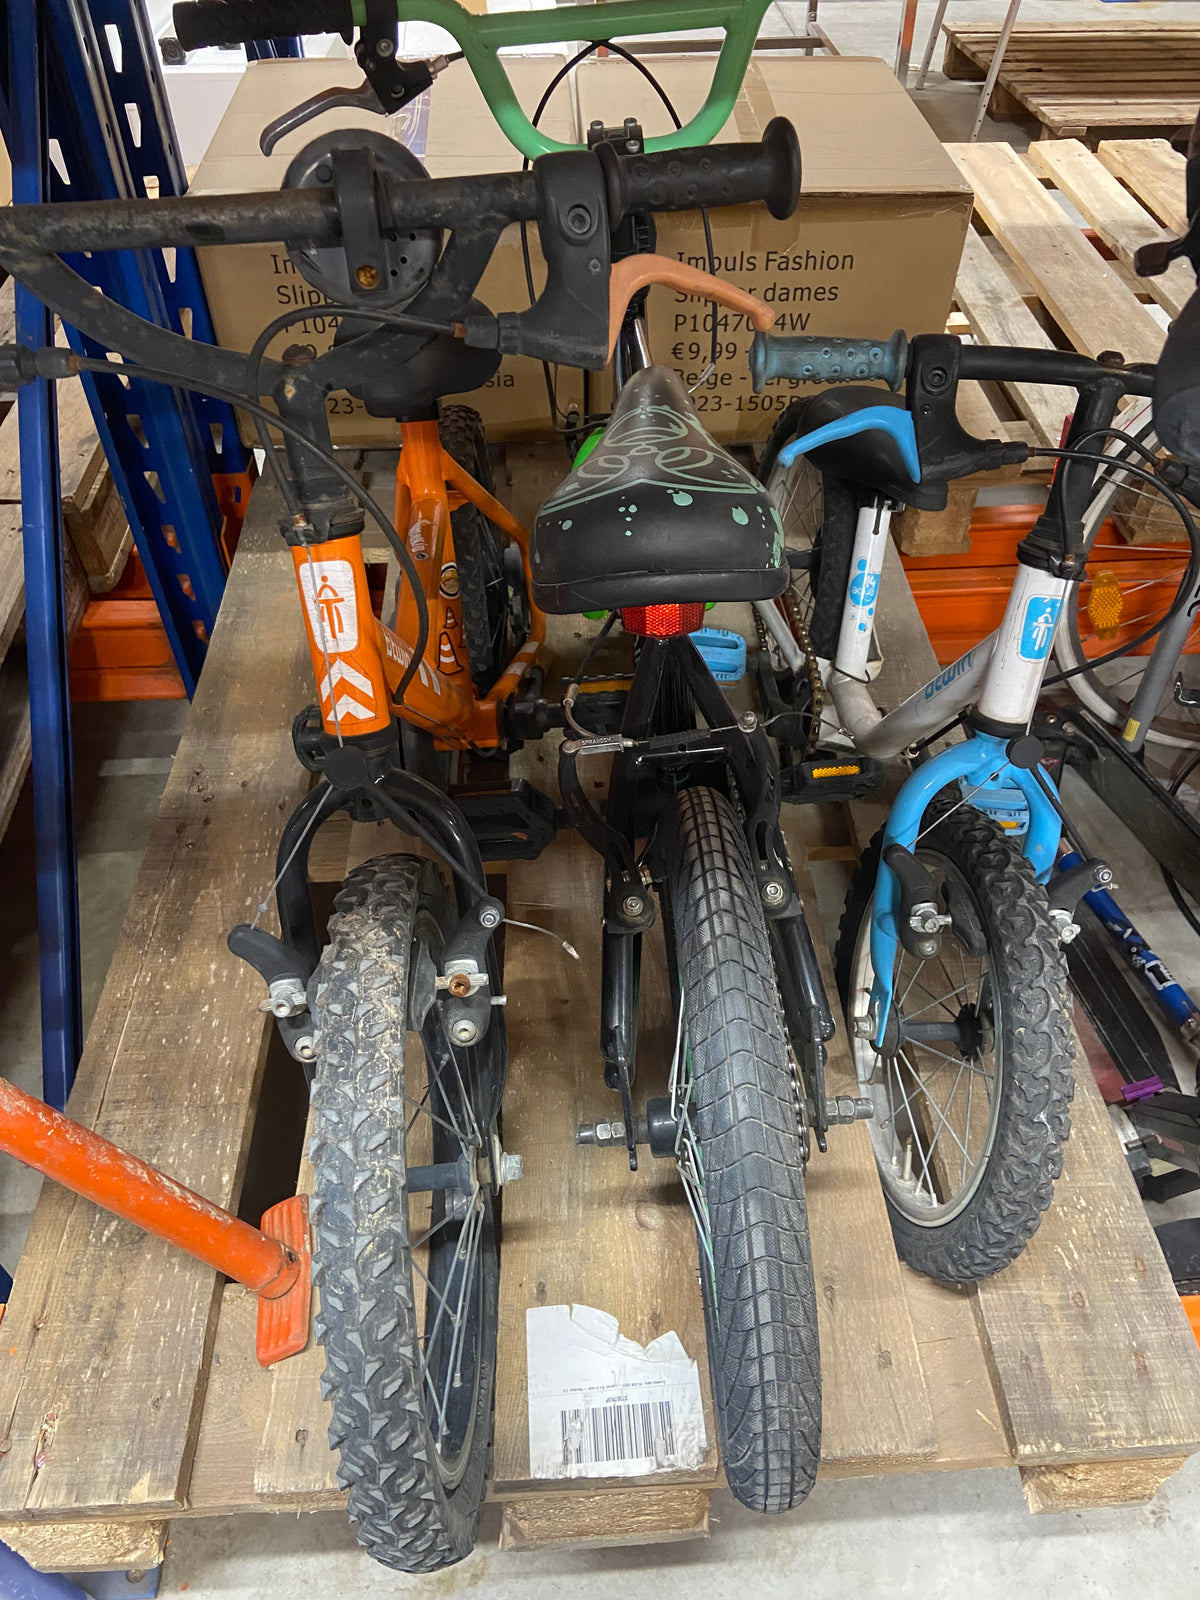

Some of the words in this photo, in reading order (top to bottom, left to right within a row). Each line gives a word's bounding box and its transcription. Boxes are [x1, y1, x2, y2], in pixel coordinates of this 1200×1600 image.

[765, 249, 854, 272] Fashion
[763, 282, 839, 303] dames
[674, 312, 811, 333] P10474W
